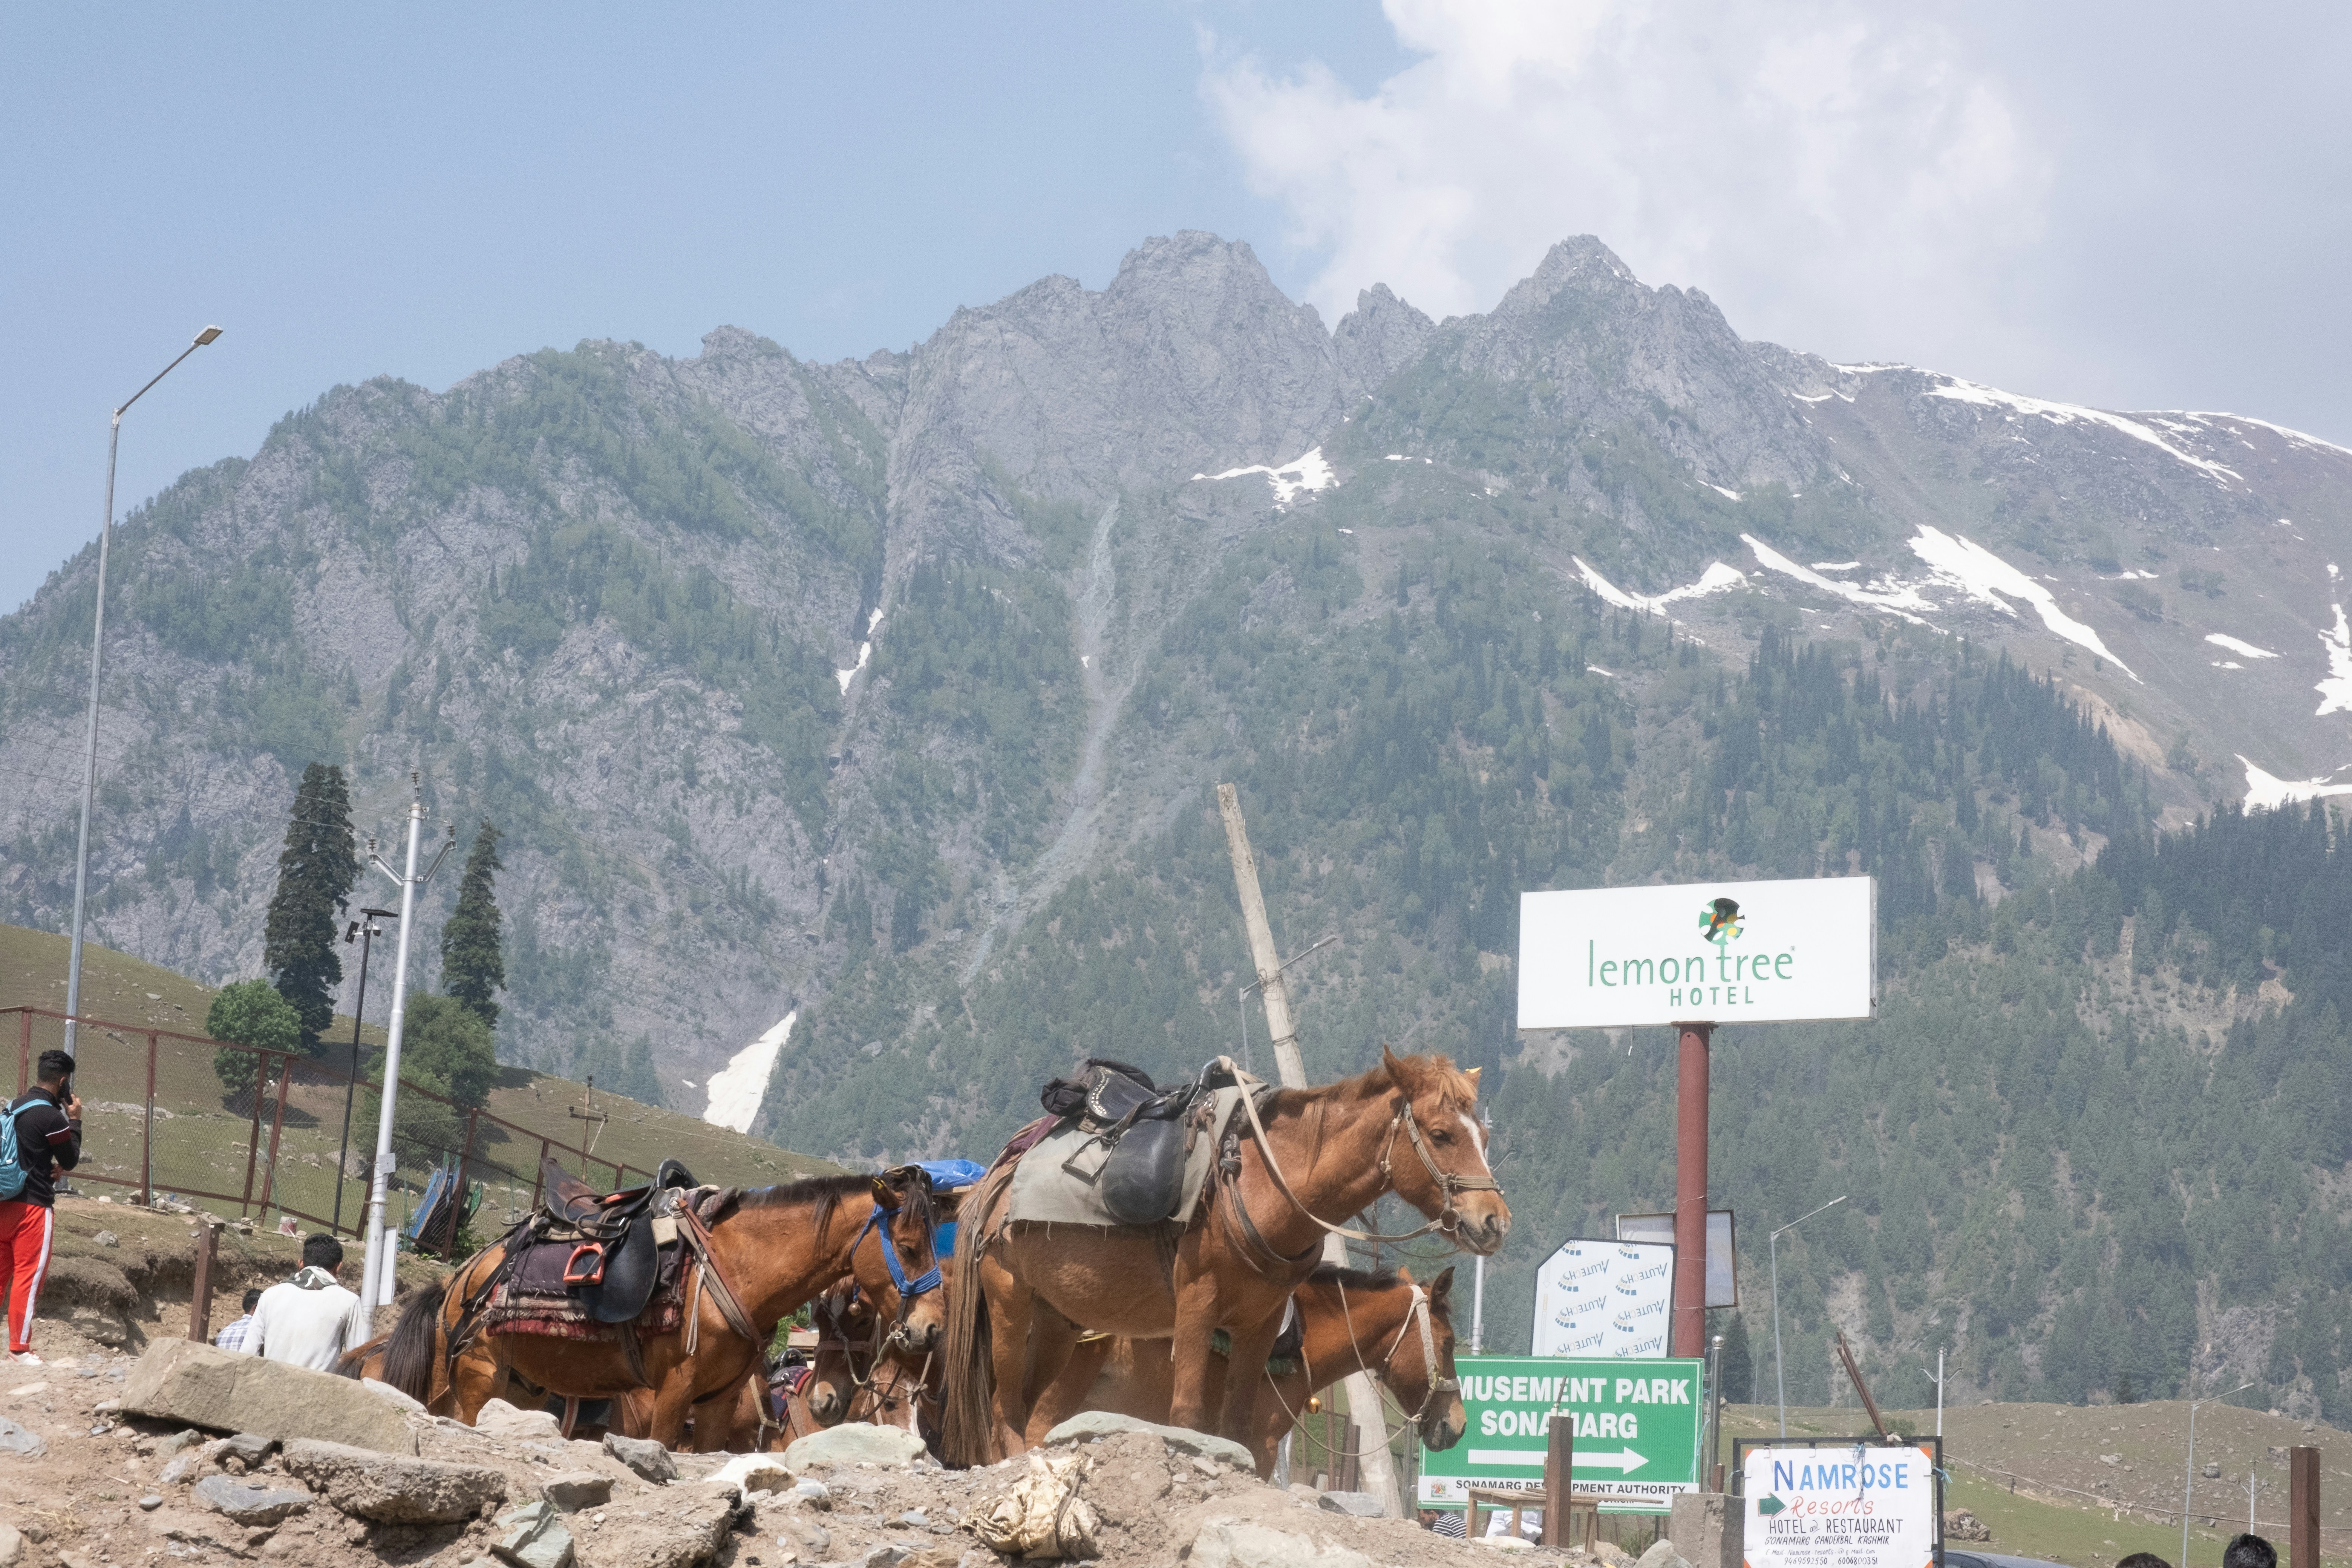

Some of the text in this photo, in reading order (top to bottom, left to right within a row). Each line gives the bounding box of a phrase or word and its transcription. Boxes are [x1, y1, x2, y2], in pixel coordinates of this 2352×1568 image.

[1588, 939, 1704, 986] lemon
[1670, 986, 1754, 1007] HOTEL
[1457, 1375, 1690, 1404] MUSEMENT PARK
[1774, 1460, 1908, 1491] NAMROSE
[1456, 1480, 1522, 1490] SONAMARG
[1617, 1484, 1686, 1494] AUTHORITY
[1790, 1496, 1874, 1518] Resorts
[1769, 1519, 1807, 1534] HOTEL
[1826, 1518, 1903, 1534] RESTAURANT
[1765, 1535, 1890, 1545] SONAMARG GANDERBAL KASHMIR
